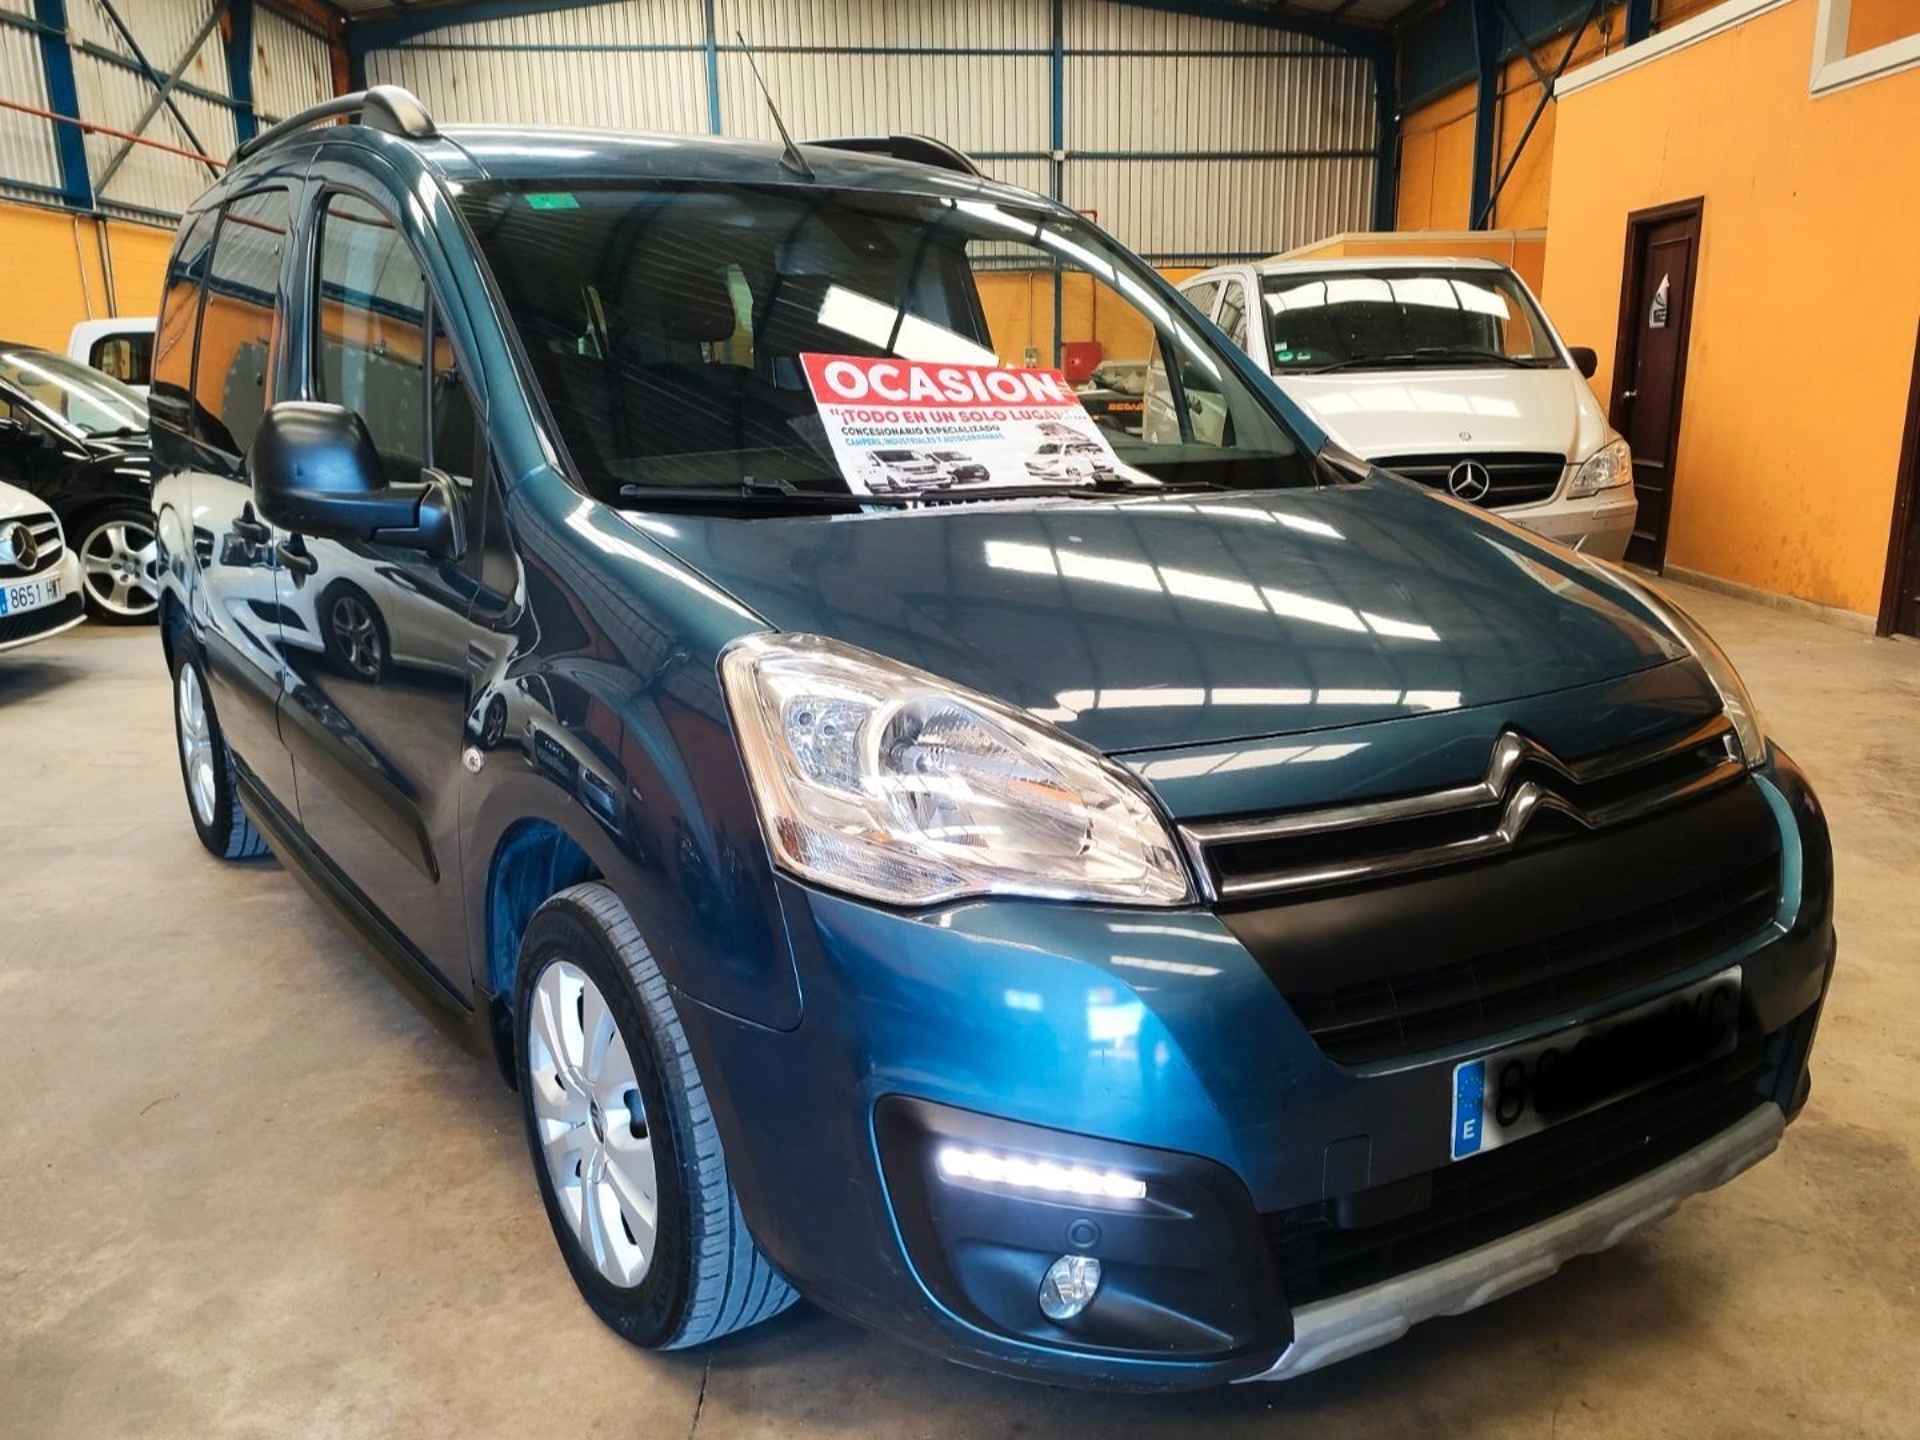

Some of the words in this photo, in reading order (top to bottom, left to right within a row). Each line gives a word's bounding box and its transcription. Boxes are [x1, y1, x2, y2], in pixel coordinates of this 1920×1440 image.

[824, 361, 1066, 401] OCASION
[902, 411, 928, 424] EN
[929, 411, 956, 423] UN
[959, 411, 1007, 422] SOLO
[841, 427, 923, 436] CONCESIONARIO
[924, 425, 1000, 435] ESPECIALIZADO
[10, 583, 41, 608] 8651
[1462, 1119, 1475, 1140] E
